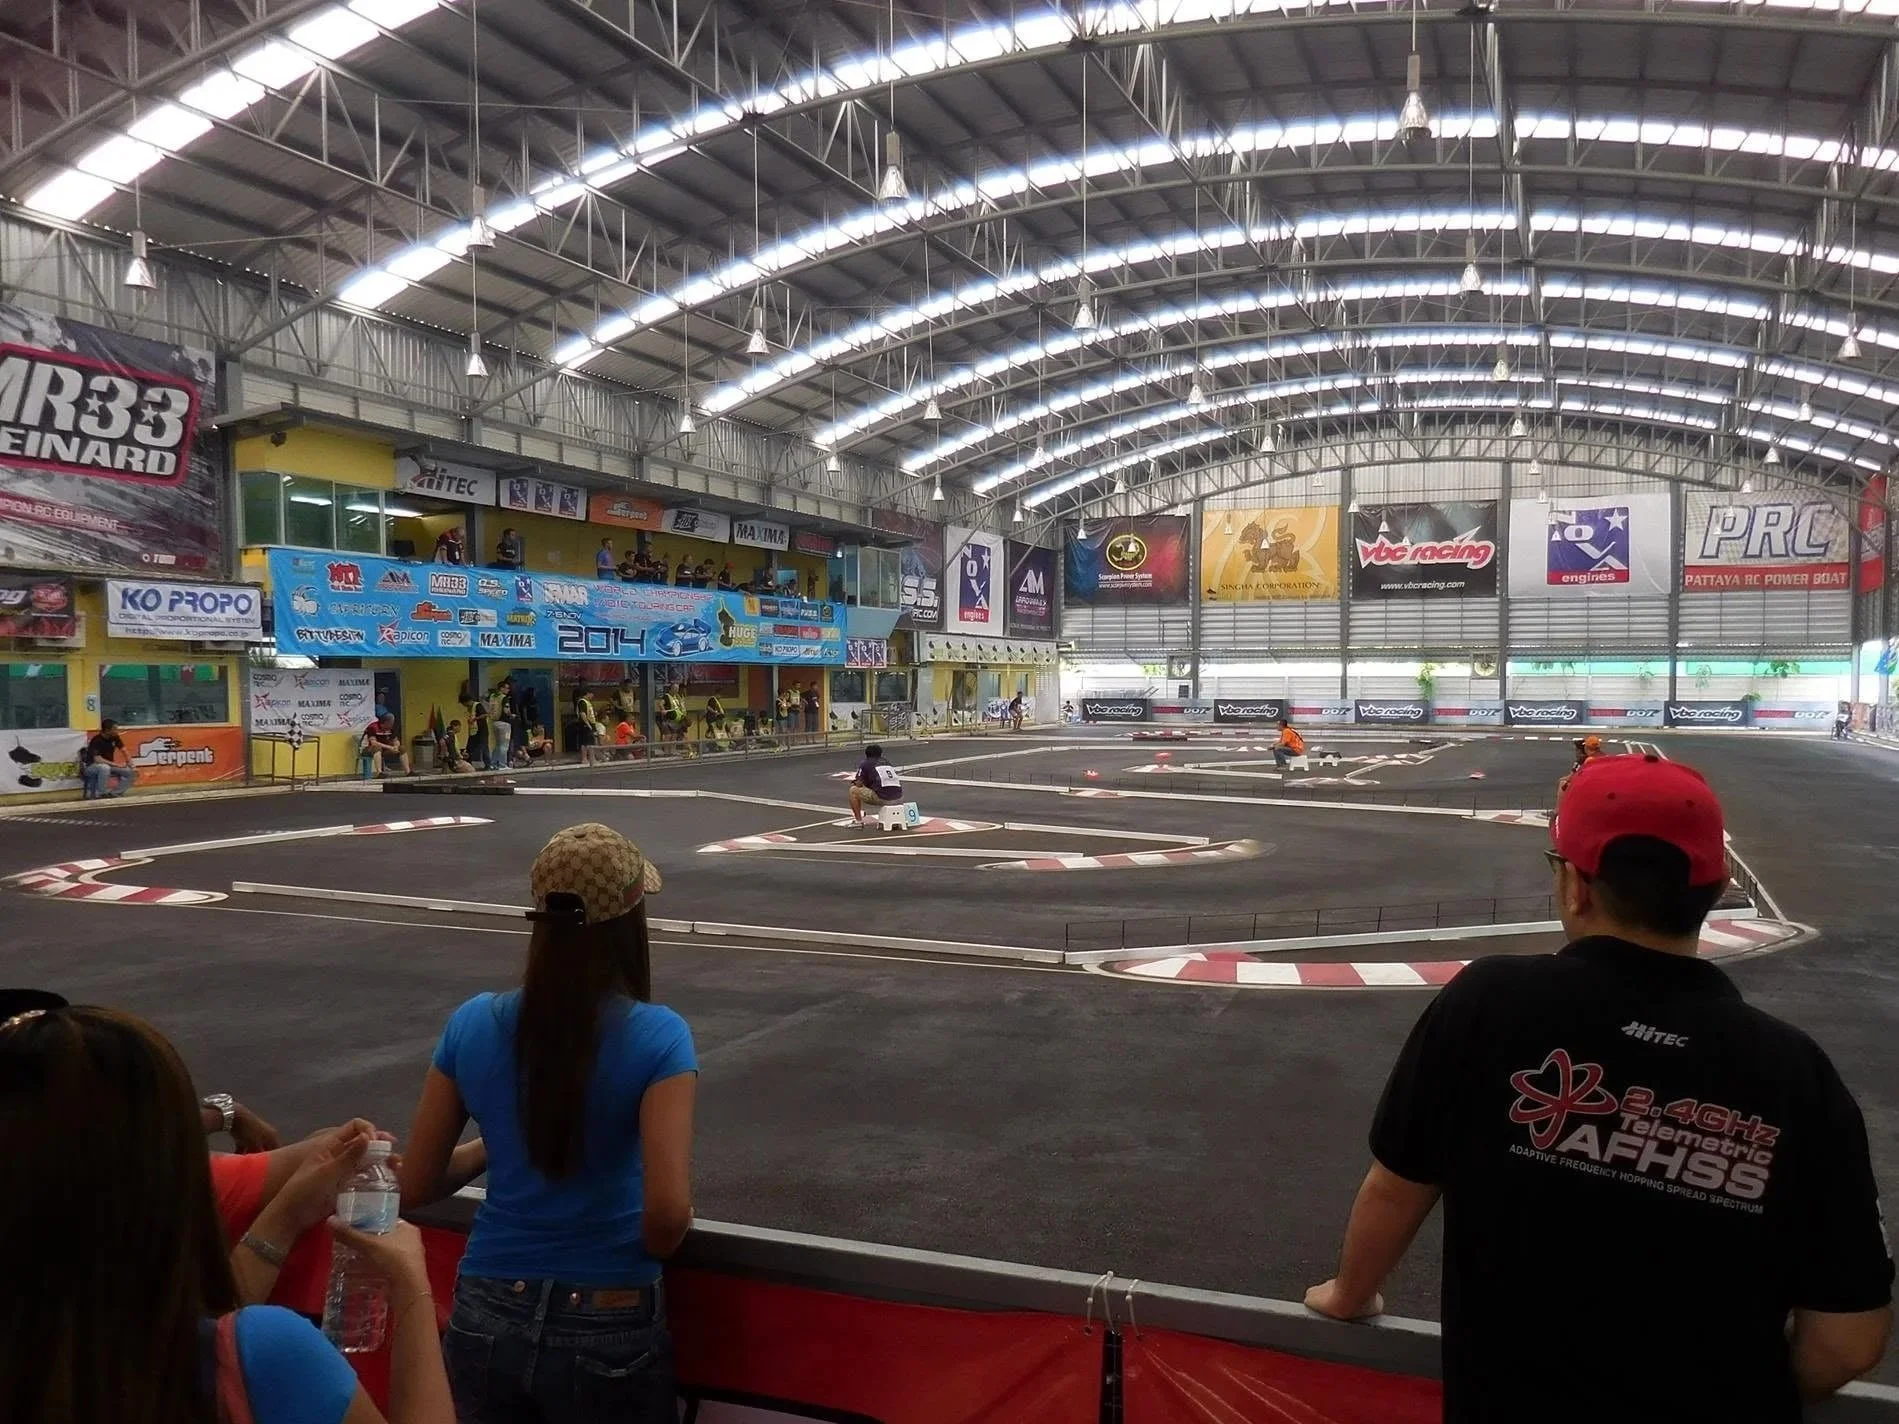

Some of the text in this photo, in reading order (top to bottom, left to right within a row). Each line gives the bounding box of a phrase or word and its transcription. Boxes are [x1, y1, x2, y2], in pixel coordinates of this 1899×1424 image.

[736, 523, 784, 545] MAXIMA
[1698, 501, 1836, 560] PRC
[1550, 511, 1627, 570] NOVA
[1409, 538, 1494, 568] racing
[961, 544, 989, 609] NOVA
[1135, 572, 1152, 580] System
[1560, 572, 1616, 584] engines
[1685, 573, 1847, 586] PATTAYA RC POWER BOAT
[1221, 581, 1320, 591] SINGHA CORPORATION
[1380, 581, 1465, 591] www.vbcracing.com
[121, 587, 252, 615] KO PROPO
[643, 588, 713, 601] CHAMPIONSHIP
[557, 623, 647, 656] 2014
[728, 627, 756, 638] HUGE
[480, 633, 533, 647] MAXIMA
[1108, 703, 1143, 716] racing
[1241, 703, 1279, 717] racing
[1384, 704, 1423, 718] racing
[1534, 705, 1577, 719] racing
[1697, 706, 1742, 720] racing
[131, 737, 215, 768] Serpent
[908, 808, 917, 822] 9
[1619, 1085, 1781, 1147] 2.4GHz
[1619, 1112, 1774, 1165] Telemetric
[1555, 1123, 1770, 1200] AFHSS
[1509, 1143, 1764, 1215] ADAPTIVE FREQUENCY HOPPING SPREAD SPECTRUM
